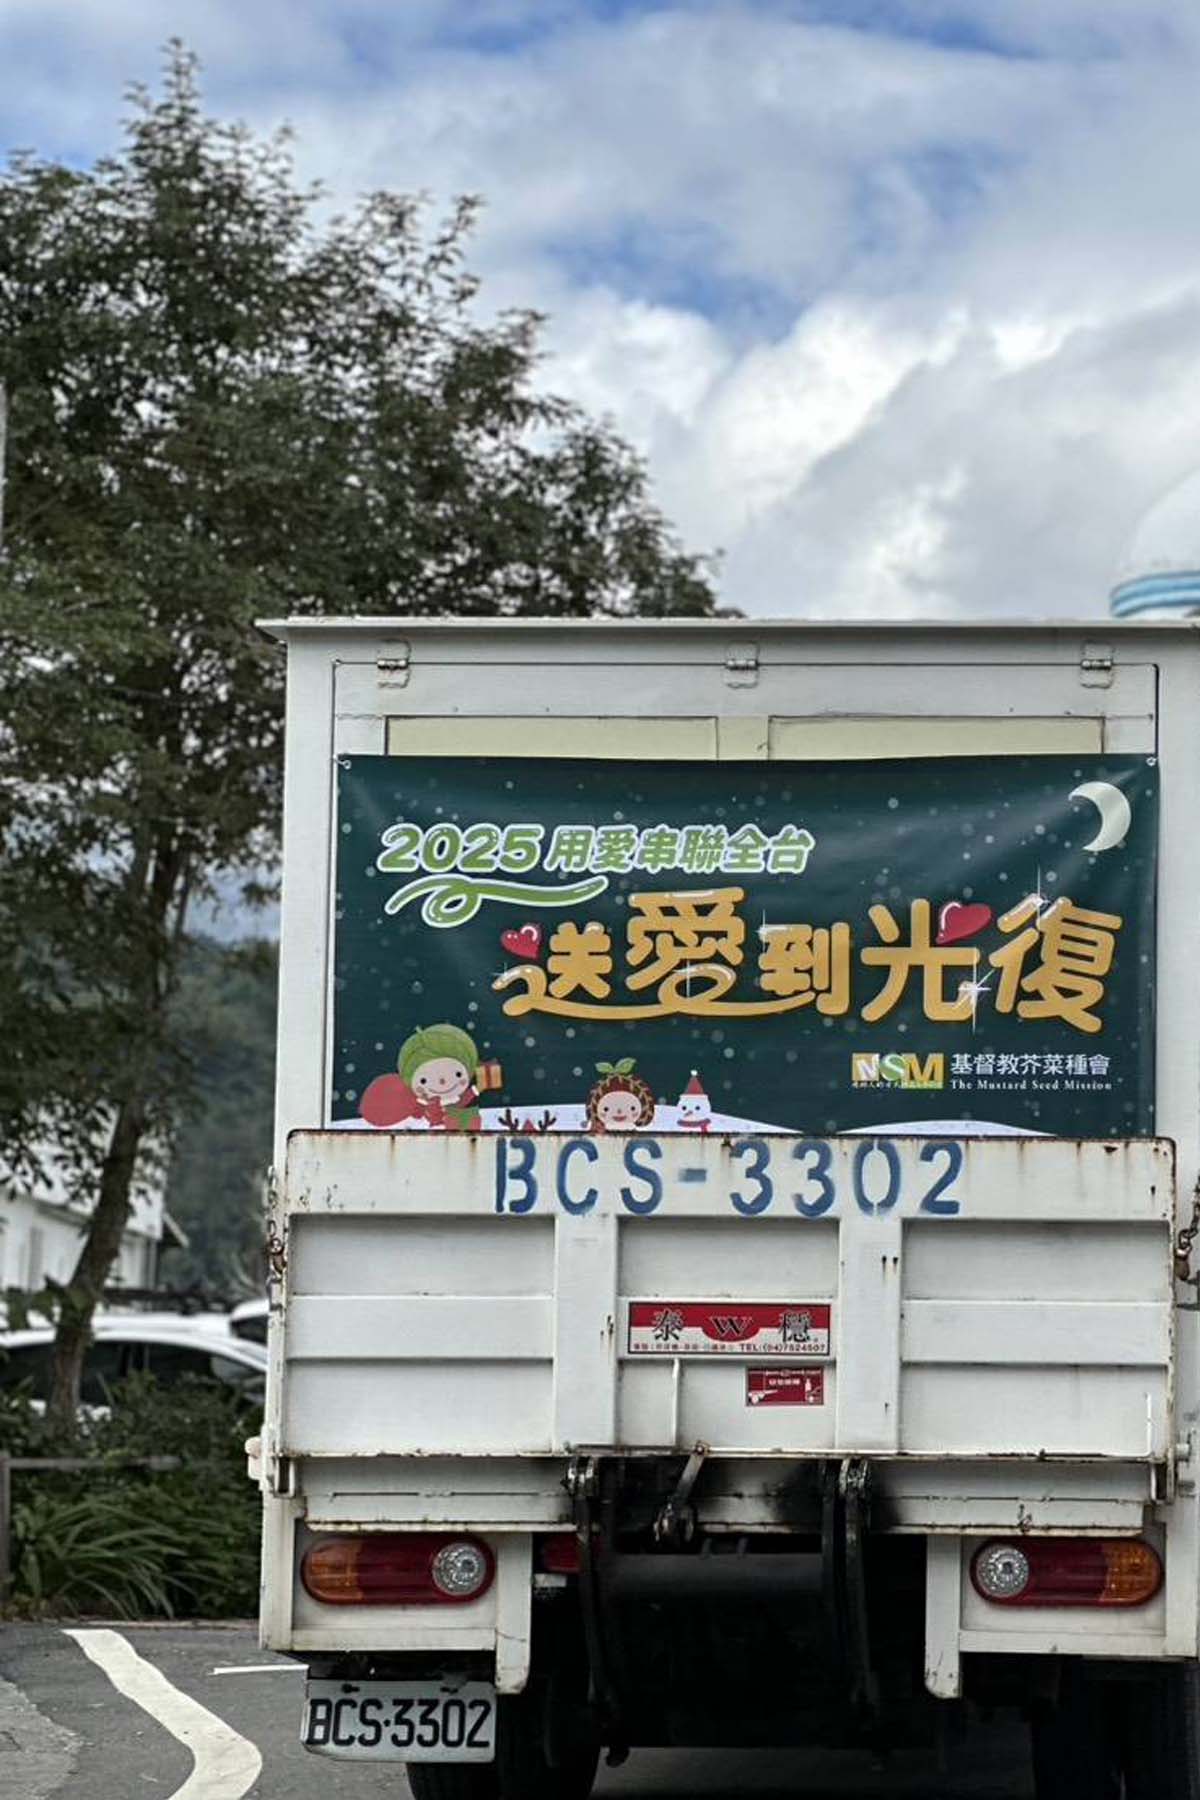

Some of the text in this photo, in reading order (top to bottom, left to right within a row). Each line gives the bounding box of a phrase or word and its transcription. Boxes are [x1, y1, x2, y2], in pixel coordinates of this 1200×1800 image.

[376, 822, 816, 874] 2025 用愛串聯全台
[492, 887, 1123, 1034] 送愛到光復
[950, 1053, 1111, 1076] 基督教芥菜種會
[950, 1079, 973, 1090] The
[977, 1079, 1027, 1090] Mustard
[1032, 1079, 1059, 1090] Seed
[1064, 1079, 1112, 1090] Mission
[494, 1137, 964, 1216] BCS-3302
